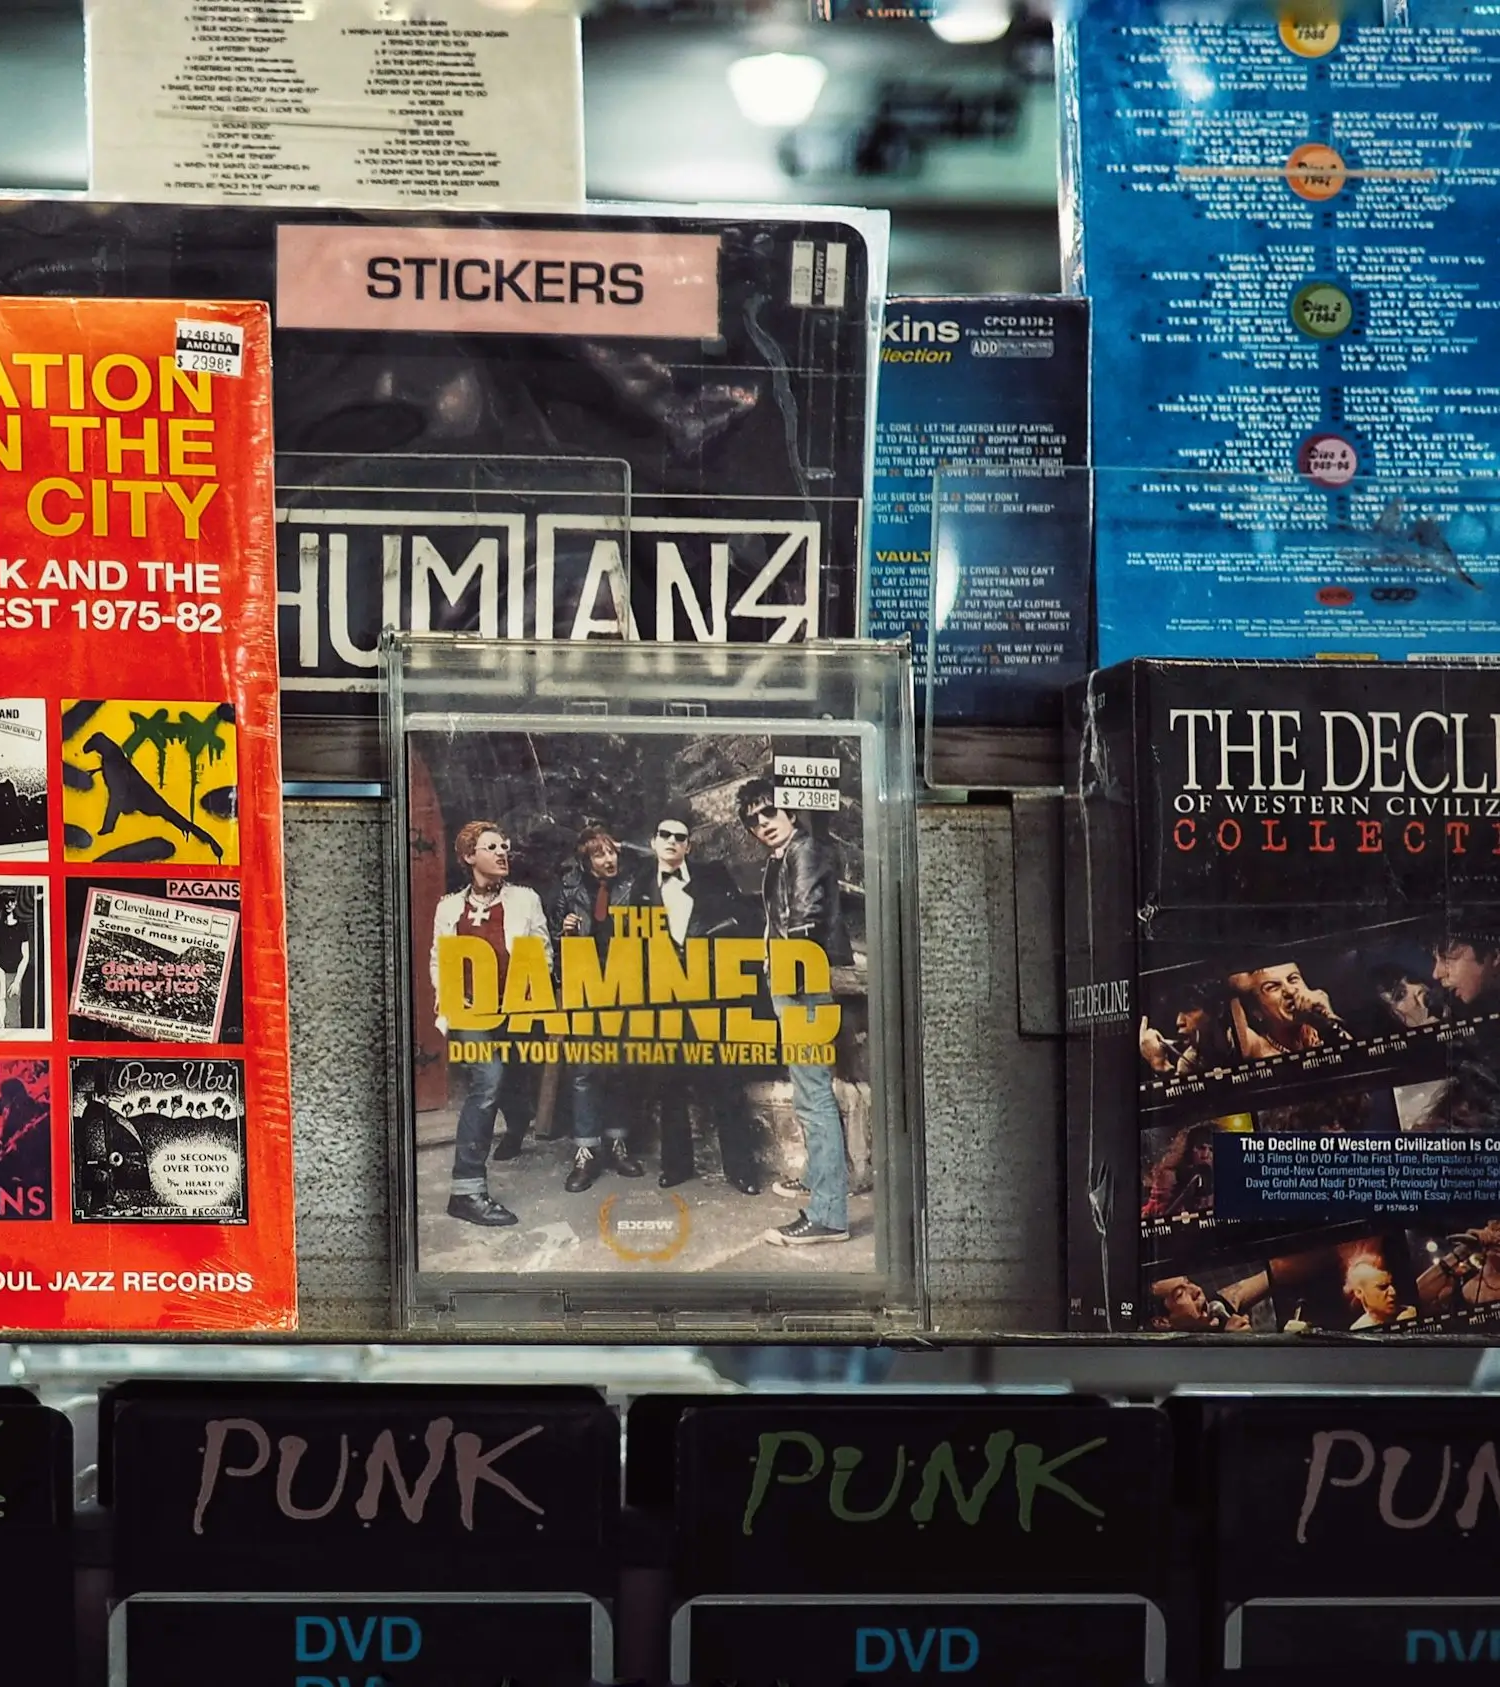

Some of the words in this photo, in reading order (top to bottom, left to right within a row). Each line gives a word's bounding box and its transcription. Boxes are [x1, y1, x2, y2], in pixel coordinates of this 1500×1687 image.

[366, 256, 645, 306] STICKERS
[984, 316, 1016, 326] CPCD
[186, 341, 232, 353] AMOEBA
[973, 343, 998, 354] ADD
[924, 424, 937, 433] LET
[941, 424, 956, 433] THE
[49, 416, 219, 476] THE
[25, 476, 221, 540] CITY
[38, 559, 129, 592] AND
[138, 561, 222, 594] THE
[71, 599, 223, 633] 1975-82
[1169, 709, 1305, 791] THE
[784, 777, 829, 787] AMOEBA
[1174, 794, 1212, 813] OF
[1225, 795, 1370, 815] WESTERN
[169, 882, 240, 897] PAGANS
[114, 899, 170, 919] Cleveland
[175, 910, 209, 926] Press
[609, 906, 670, 940] THE
[99, 920, 131, 933] Scene
[135, 927, 146, 935] of
[150, 930, 178, 942] mass
[181, 936, 220, 949] suicide
[105, 978, 201, 994] america
[437, 933, 843, 1045] DAMNED
[1087, 980, 1129, 1016] DECLINE
[448, 1040, 509, 1064] DON'T
[516, 1040, 559, 1064] YOU
[564, 1041, 620, 1064] WISH
[625, 1042, 677, 1065] THAT
[684, 1042, 715, 1065] WE
[719, 1042, 778, 1065] WERE
[782, 1042, 837, 1066] DEAD
[118, 1062, 177, 1089] Pere
[183, 1062, 233, 1090] Ubu
[1240, 1138, 1264, 1151] The
[1268, 1138, 1318, 1151] Decline
[1320, 1138, 1335, 1151] Of
[1337, 1138, 1391, 1151] Western
[1395, 1138, 1466, 1151] Civilization
[1470, 1138, 1481, 1151] Is
[163, 1164, 189, 1172] OVER
[194, 1164, 229, 1173] TOKYO
[1243, 1153, 1256, 1163] All
[1258, 1153, 1264, 1163] 3
[1267, 1153, 1293, 1164] Films
[1296, 1154, 1308, 1163] On
[1311, 1154, 1331, 1164] DVD
[1334, 1154, 1349, 1164] For
[1352, 1154, 1369, 1164] The
[1372, 1154, 1392, 1164] First
[1394, 1154, 1420, 1165] Time,
[1261, 1165, 1315, 1176] Brand-New
[1317, 1166, 1385, 1176] Commentaries
[1388, 1166, 1400, 1178] By
[1403, 1166, 1439, 1176] Director
[1246, 1178, 1269, 1188] Dave
[1272, 1178, 1297, 1188] Grohl
[1300, 1178, 1318, 1188] And
[1320, 1178, 1345, 1188] Nadir
[1391, 1179, 1438, 1190] Previously
[1262, 1190, 1329, 1201] Performances;
[1332, 1190, 1372, 1202] 40-Page
[1375, 1190, 1398, 1200] Book
[1401, 1191, 1422, 1200] With
[1424, 1191, 1450, 1202] Essay
[617, 1220, 673, 1229] SXSW
[48, 1270, 115, 1292] JAZZ
[123, 1271, 253, 1294] RECORDS
[192, 1415, 545, 1535] PUNK
[742, 1429, 1108, 1535] PUNK
[292, 1615, 424, 1664] DVD
[854, 1626, 981, 1674] DVD
